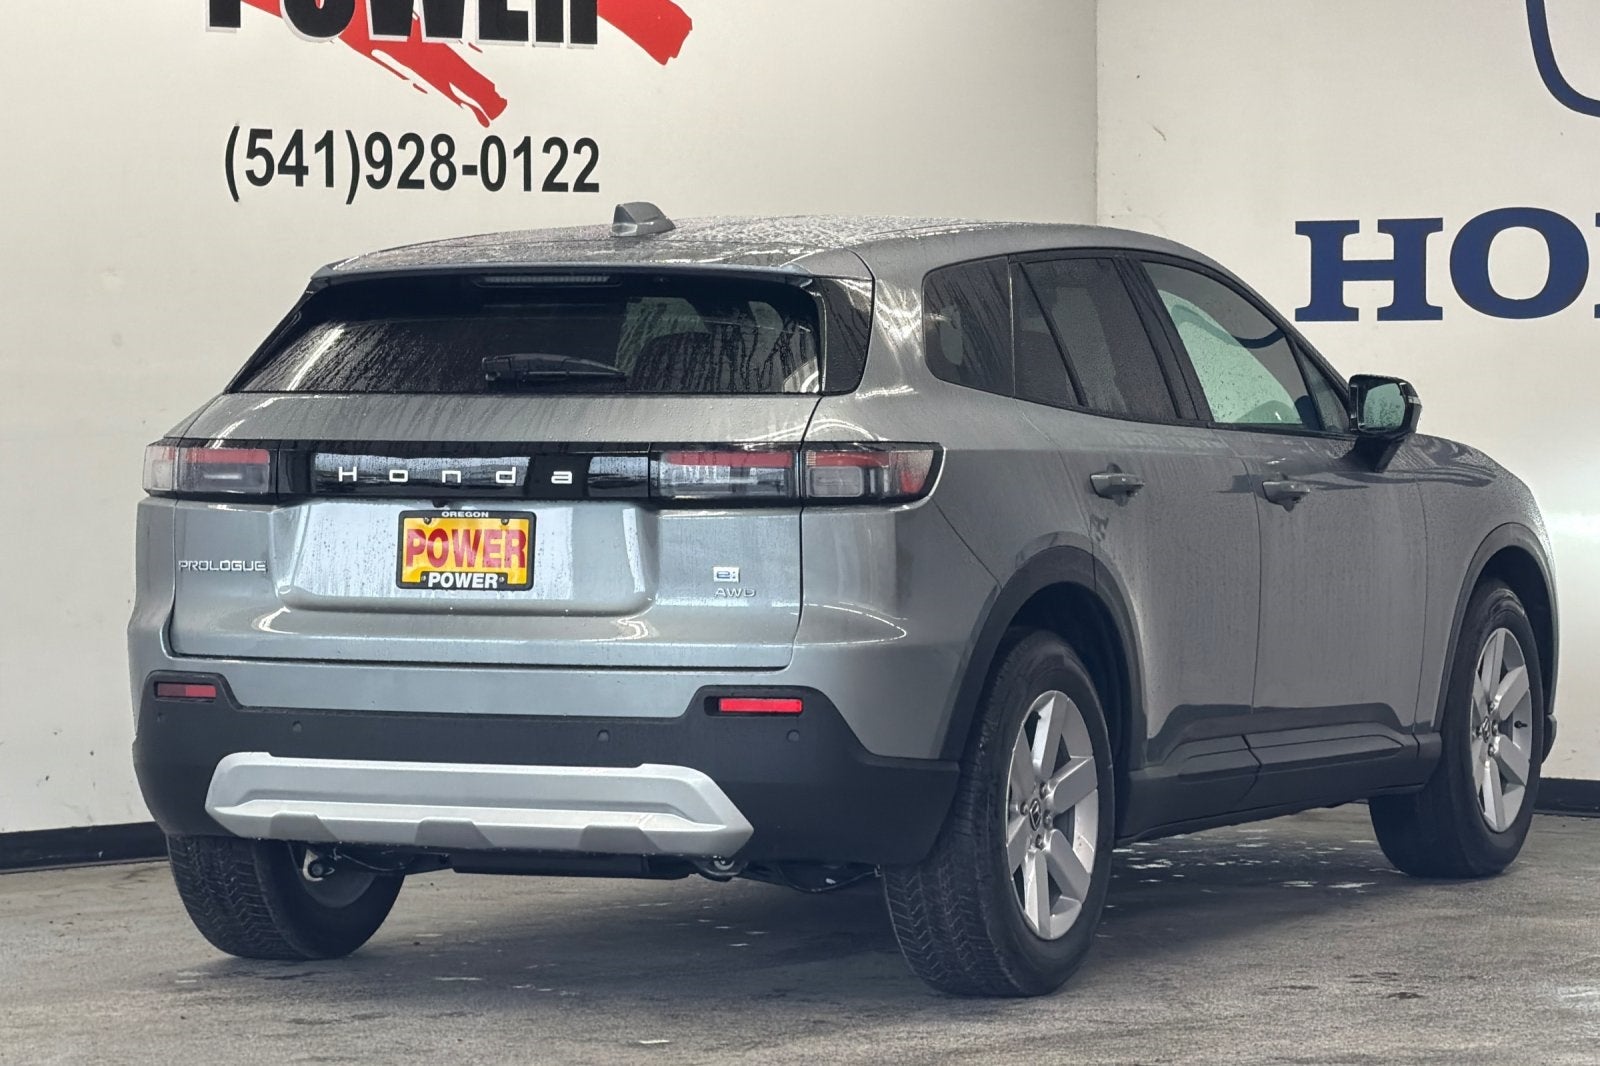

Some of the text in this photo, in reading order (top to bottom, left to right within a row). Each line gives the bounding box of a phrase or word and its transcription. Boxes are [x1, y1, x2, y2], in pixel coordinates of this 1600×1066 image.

[225, 124, 601, 204] (541)928-0122
[1295, 206, 1600, 322] HO
[405, 528, 527, 568] POWER
[178, 560, 267, 571] PROLOGUE
[428, 572, 499, 589] POWER
[714, 587, 756, 598] AWD
